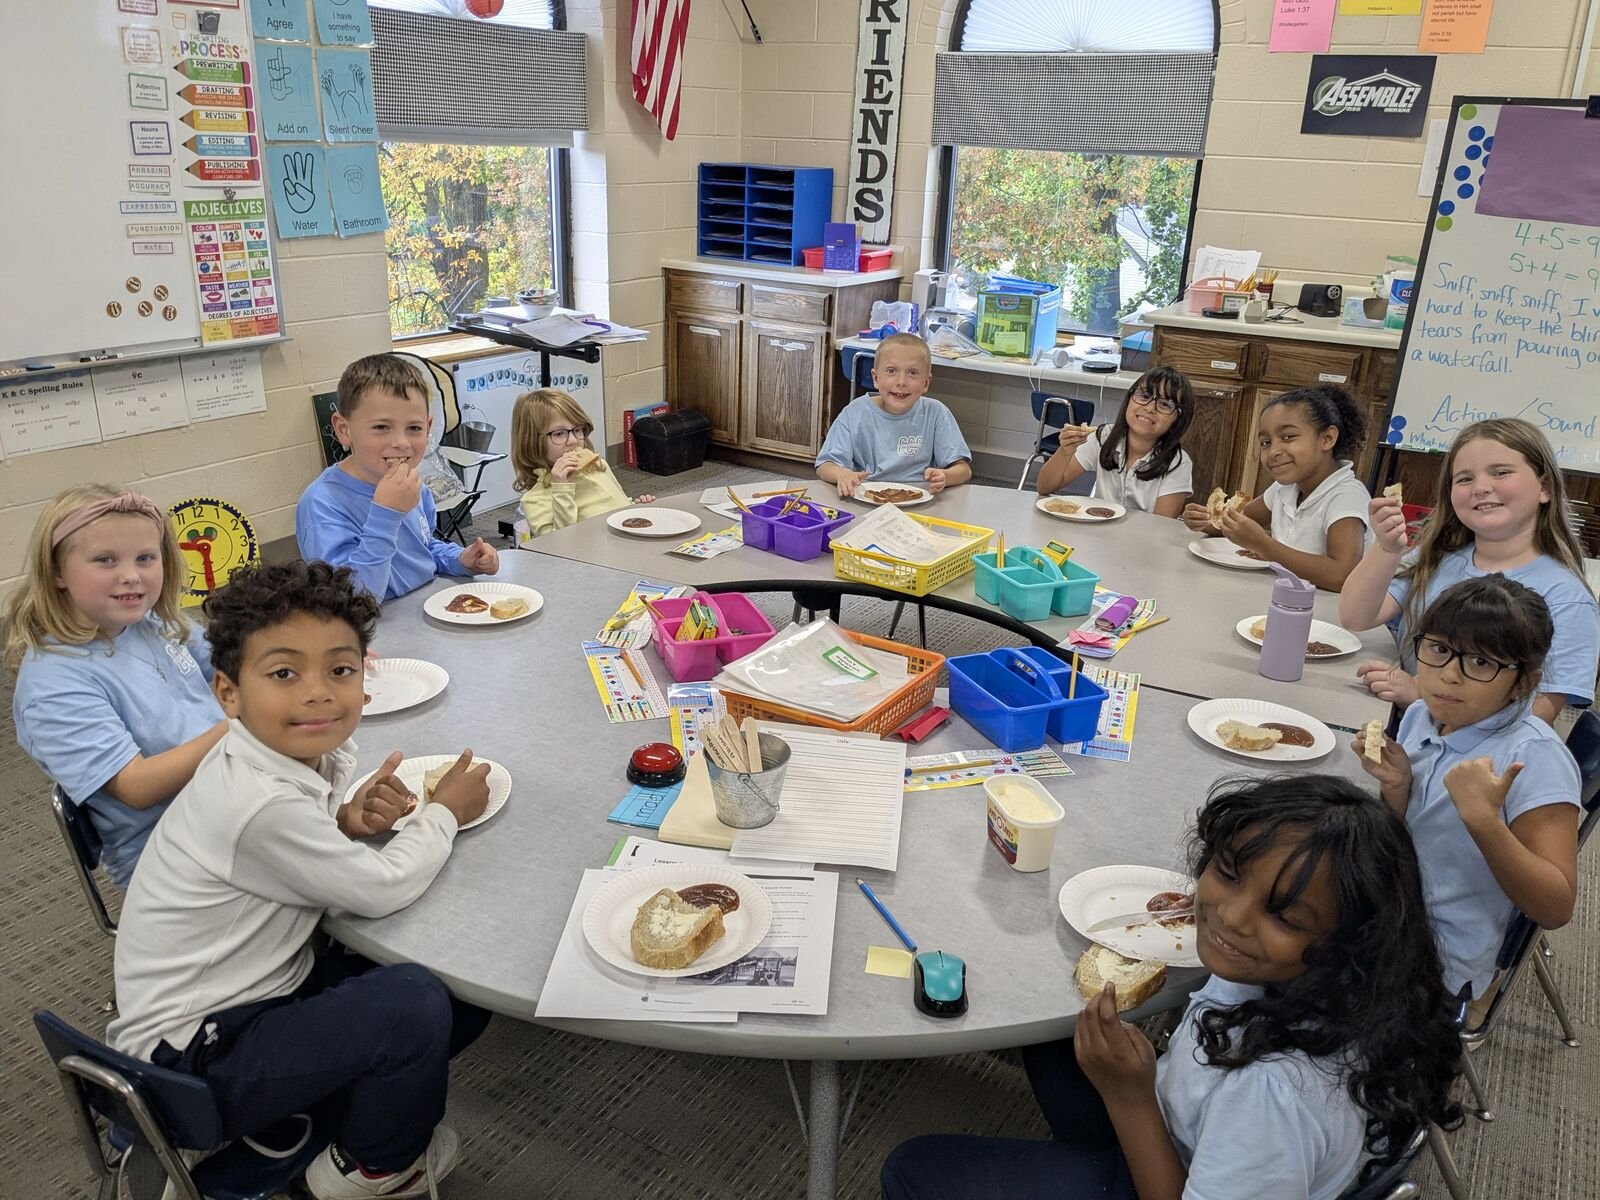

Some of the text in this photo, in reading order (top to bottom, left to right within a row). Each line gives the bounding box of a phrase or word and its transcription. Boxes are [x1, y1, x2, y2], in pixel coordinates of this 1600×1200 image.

[337, 12, 352, 20] have
[266, 17, 294, 31] Agree
[328, 23, 360, 33] something
[190, 34, 230, 44] THE WRITING
[336, 34, 356, 43] to say
[180, 40, 240, 59] PROCESS
[195, 60, 235, 70] PREWRITING
[136, 82, 161, 91] Adjective
[201, 86, 235, 95] DRAFTING
[1312, 78, 1422, 111] ASSEMBLE!
[205, 111, 237, 120] REVISING
[277, 123, 309, 134] Add on
[329, 125, 374, 135] Silent Cheer
[208, 137, 235, 145] EDITING
[131, 166, 168, 174] PHRASING
[207, 161, 246, 169] PUBLISHING
[190, 200, 263, 217] ADJECTIVES
[130, 225, 180, 233] PUNCTUATION
[291, 219, 319, 231] Water
[343, 216, 382, 230] Bathroom
[208, 312, 232, 320] DEGREES
[243, 307, 273, 316] ADJECTIVES
[1426, 299, 1463, 317] hard
[1472, 303, 1487, 319] to
[1532, 318, 1562, 335] the
[1419, 320, 1463, 339] tears
[1472, 324, 1507, 345] from
[1516, 338, 1581, 370] pouring
[1411, 349, 1513, 374] a waterfall.
[27, 384, 60, 396] Spelling
[62, 381, 84, 390] Rules
[1536, 402, 1597, 439] Sound
[1409, 432, 1438, 448] What
[191, 505, 204, 518] 12
[214, 508, 220, 519] 1
[176, 513, 186, 525] 11
[230, 519, 240, 531] 2
[240, 535, 248, 547] 3
[237, 554, 245, 566] 4
[189, 575, 197, 587] 7
[705, 734, 728, 768] Samantha
